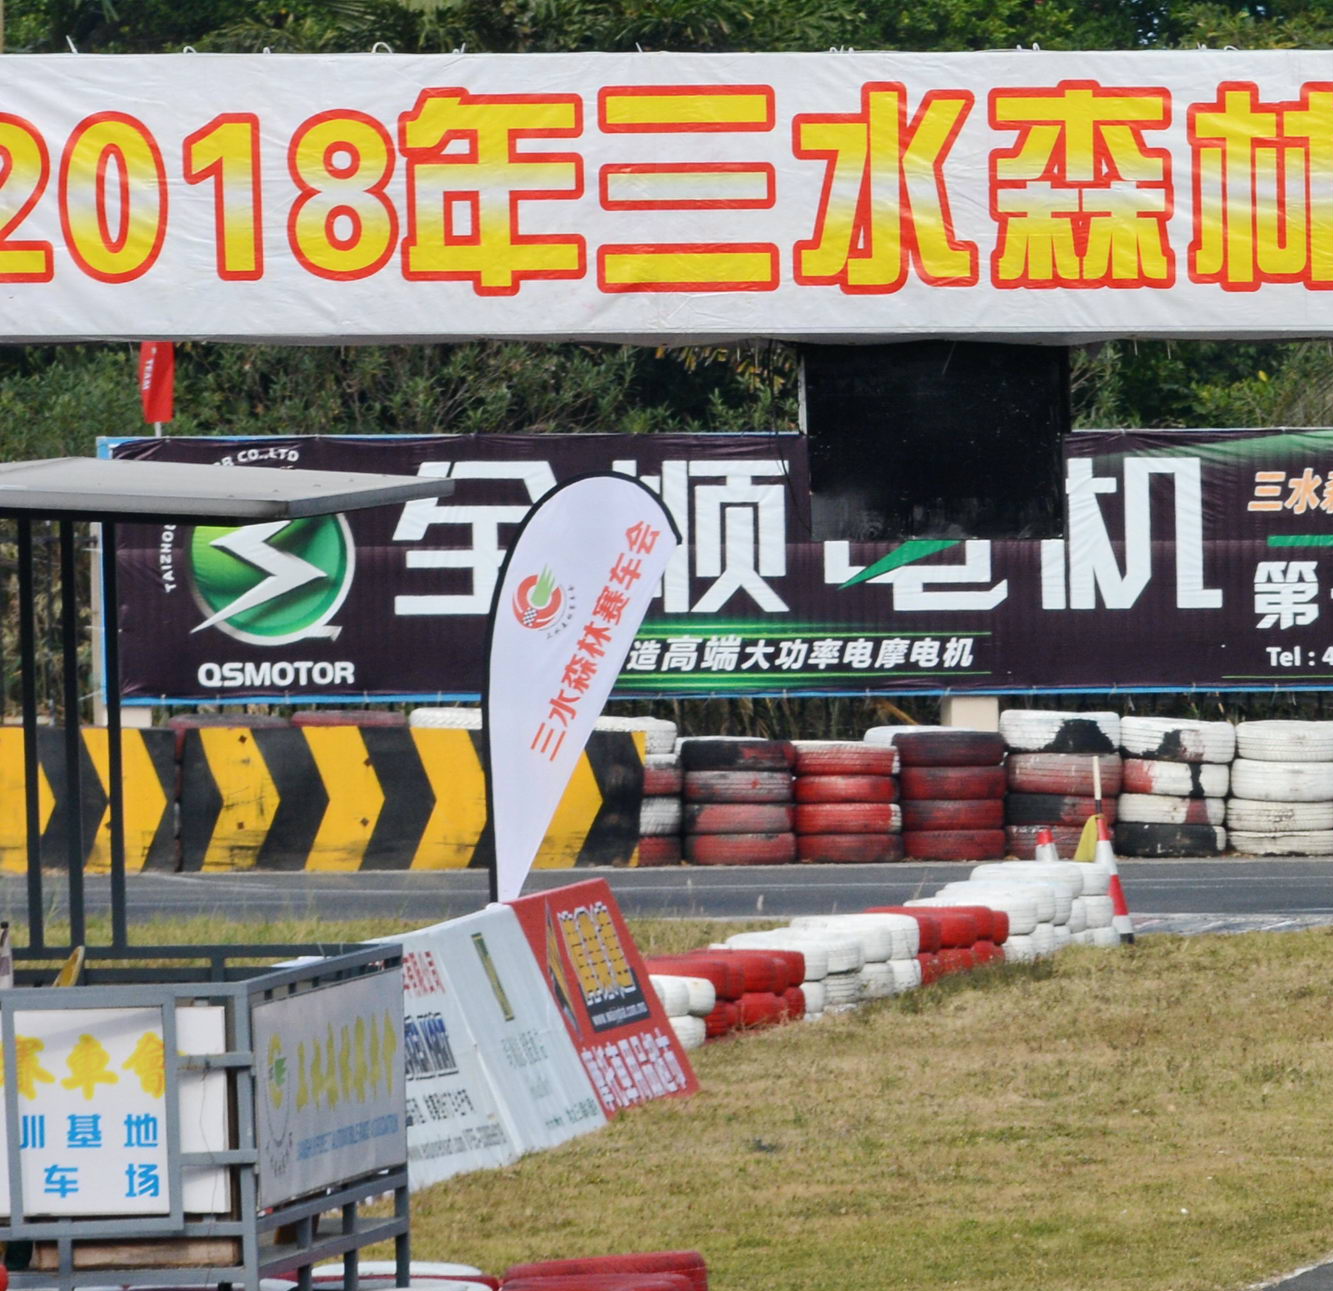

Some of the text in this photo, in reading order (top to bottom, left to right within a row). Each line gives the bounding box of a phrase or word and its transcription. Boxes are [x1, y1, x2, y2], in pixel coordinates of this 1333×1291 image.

[197, 661, 356, 688] QSMOTOR
[530, 519, 662, 763] 三水森林赛车会
